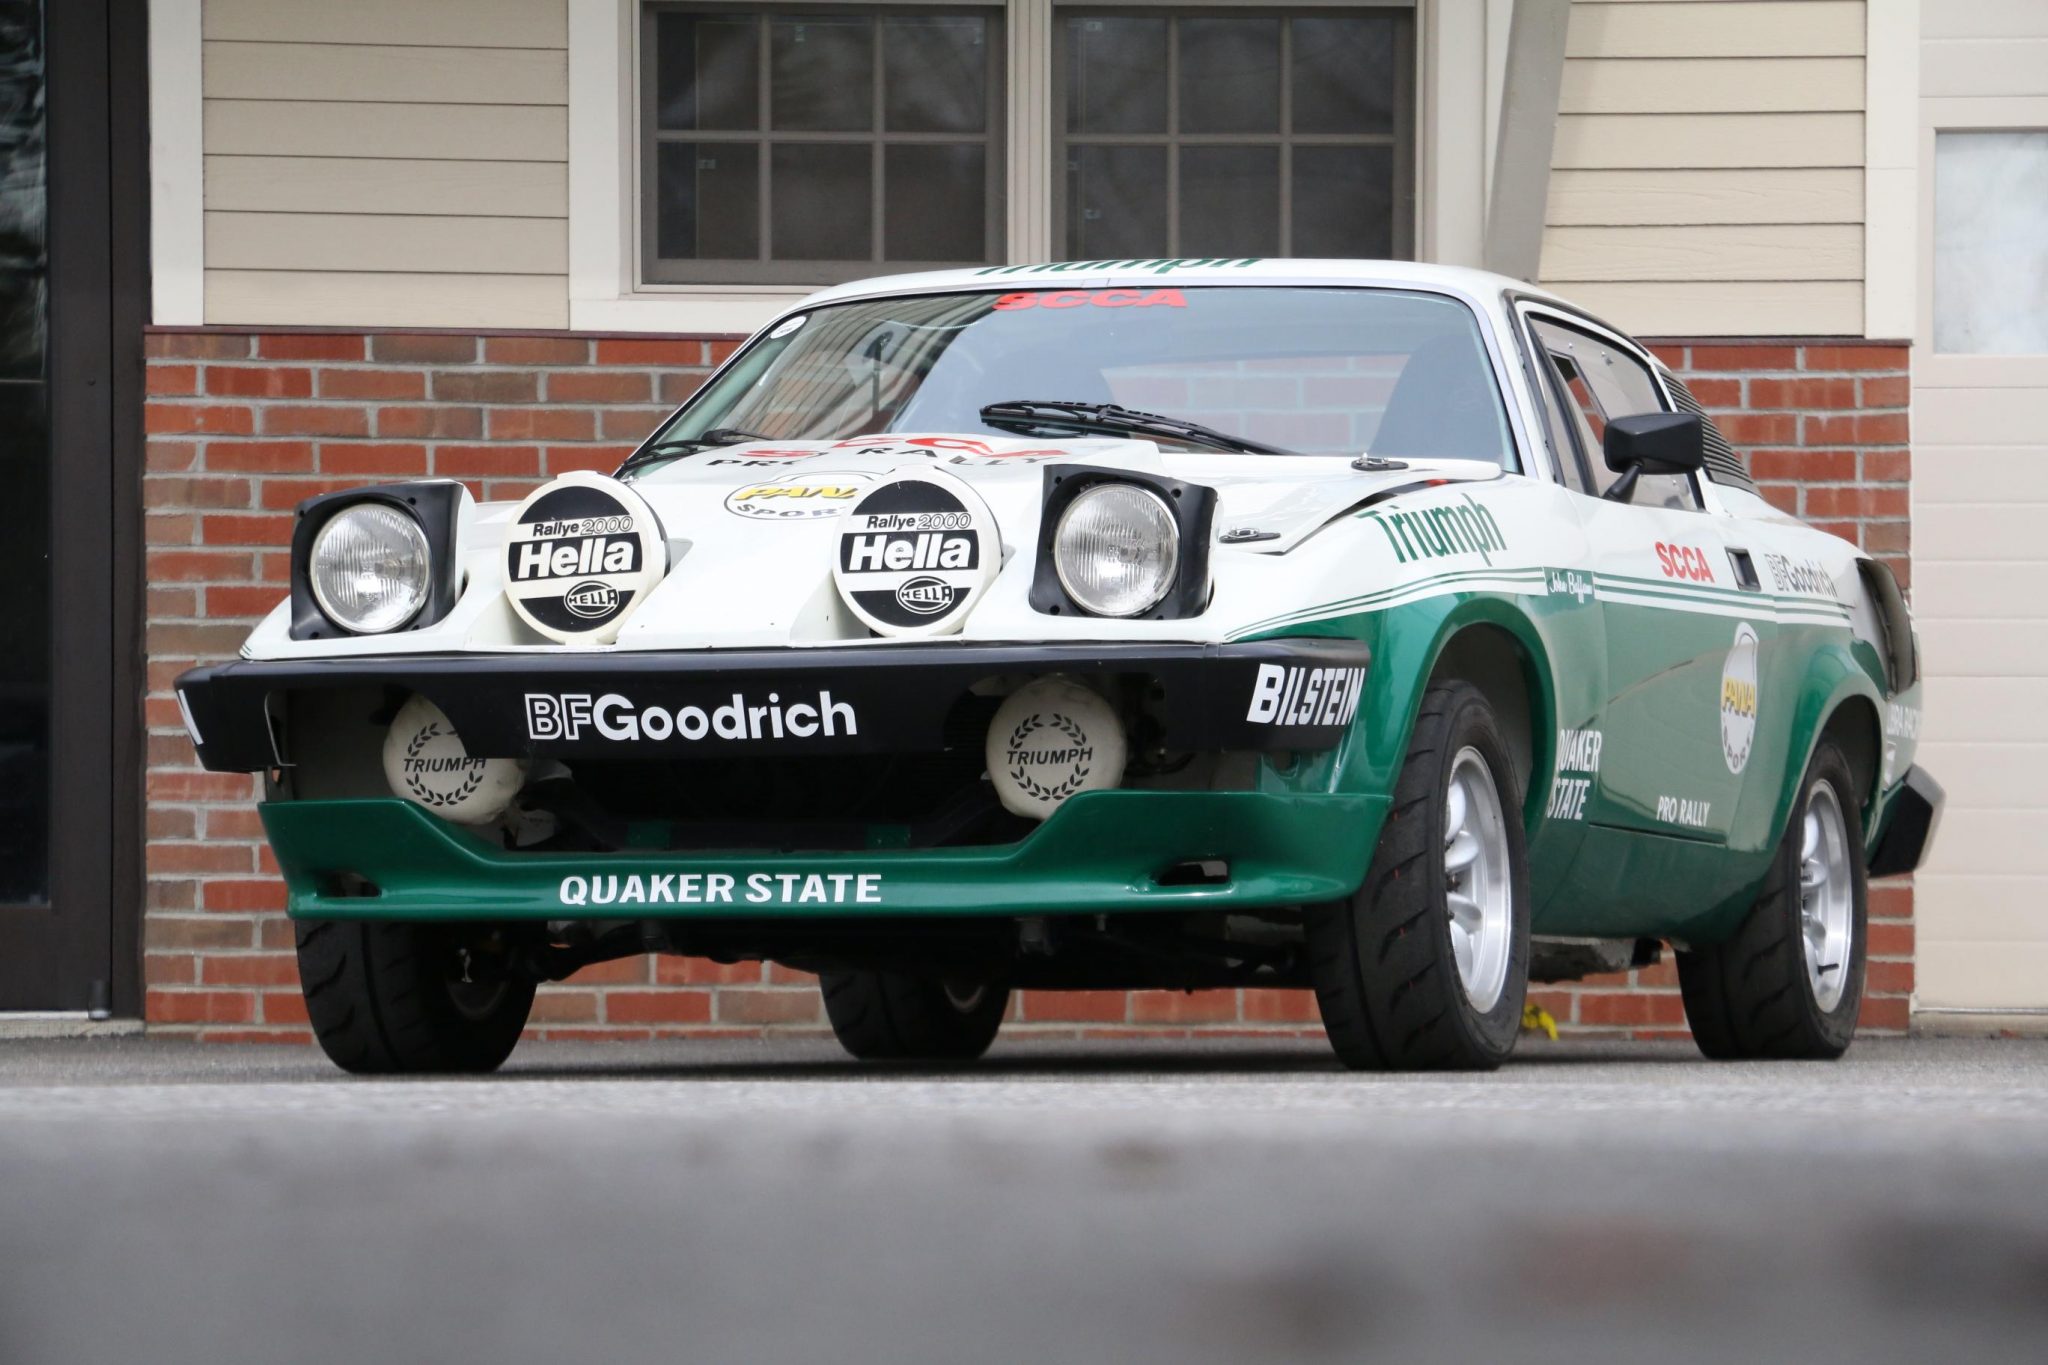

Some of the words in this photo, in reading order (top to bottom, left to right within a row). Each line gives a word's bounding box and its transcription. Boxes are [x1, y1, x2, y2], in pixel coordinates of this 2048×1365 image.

[991, 289, 1188, 311] SCCA
[532, 520, 580, 537] Rallye
[580, 515, 634, 536] 2000
[737, 504, 847, 517] SPOR
[867, 514, 916, 531] Rallye
[916, 512, 971, 530] 2000
[1353, 492, 1507, 567] Triumph
[517, 538, 634, 579] Hella
[848, 533, 971, 571] Hella
[1655, 541, 1716, 583] SCCA
[568, 588, 618, 605] HELLA
[901, 585, 953, 601] HELLA
[1246, 663, 1366, 725] BILSTEIN
[524, 690, 858, 740] BFGoodrich
[403, 757, 487, 773] TRIUMPH
[1007, 747, 1093, 765] TRIUMPH
[1547, 778, 1591, 820] STATE
[1656, 796, 1678, 823] PRO
[1679, 798, 1711, 827] RALLY
[559, 873, 735, 905] QUAKER
[745, 873, 882, 903] STATE
